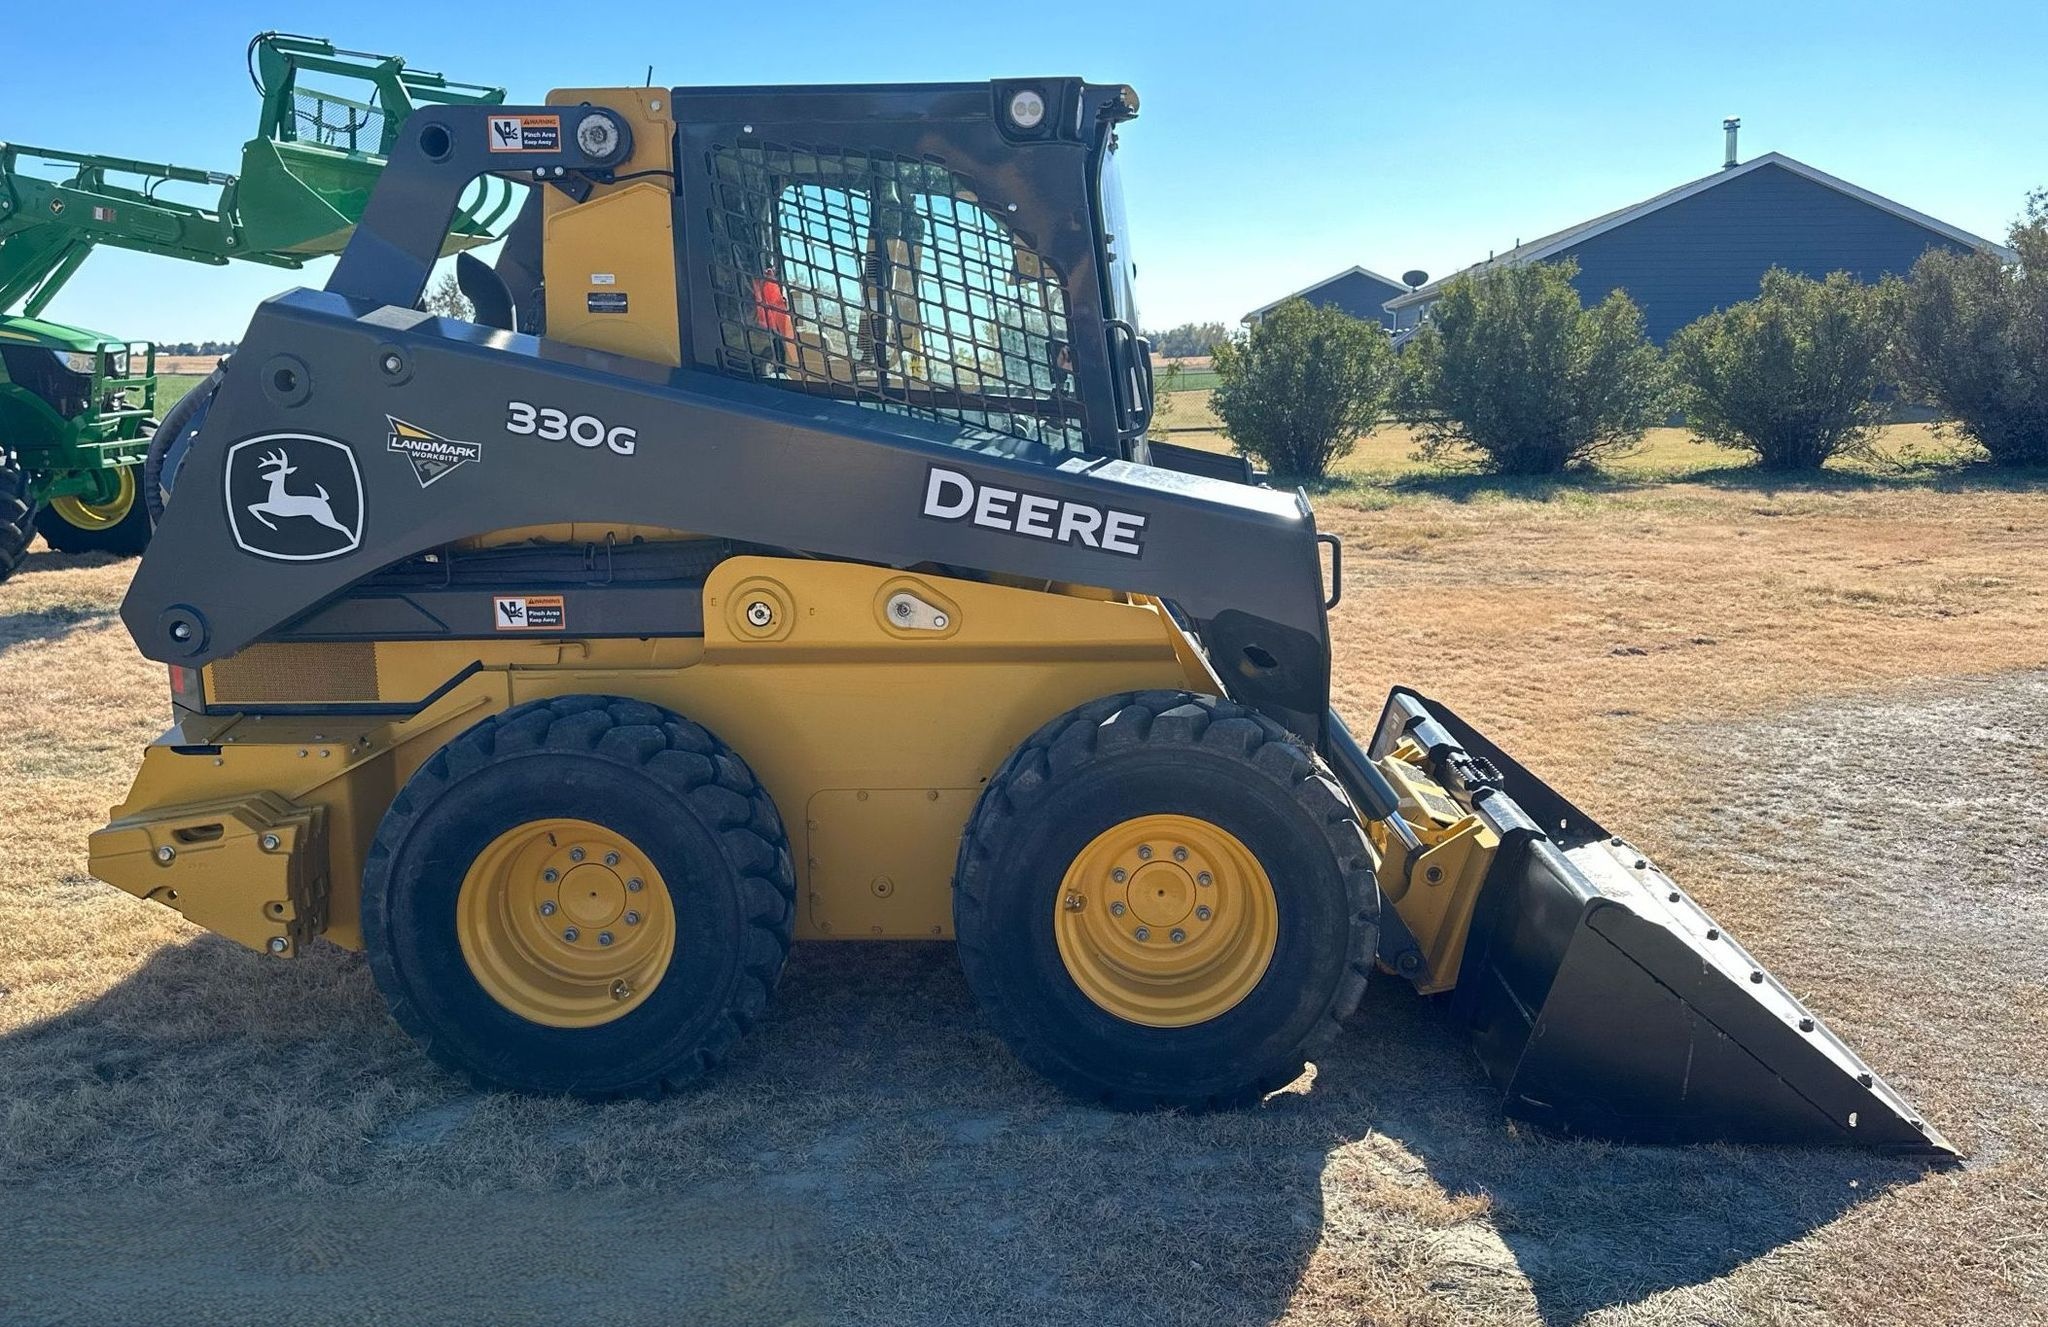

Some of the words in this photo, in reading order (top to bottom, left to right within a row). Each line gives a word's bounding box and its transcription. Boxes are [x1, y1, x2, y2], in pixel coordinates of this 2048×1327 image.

[506, 401, 637, 455] 330G
[411, 450, 459, 462] WORKSITE
[923, 467, 1146, 555] DEERE
